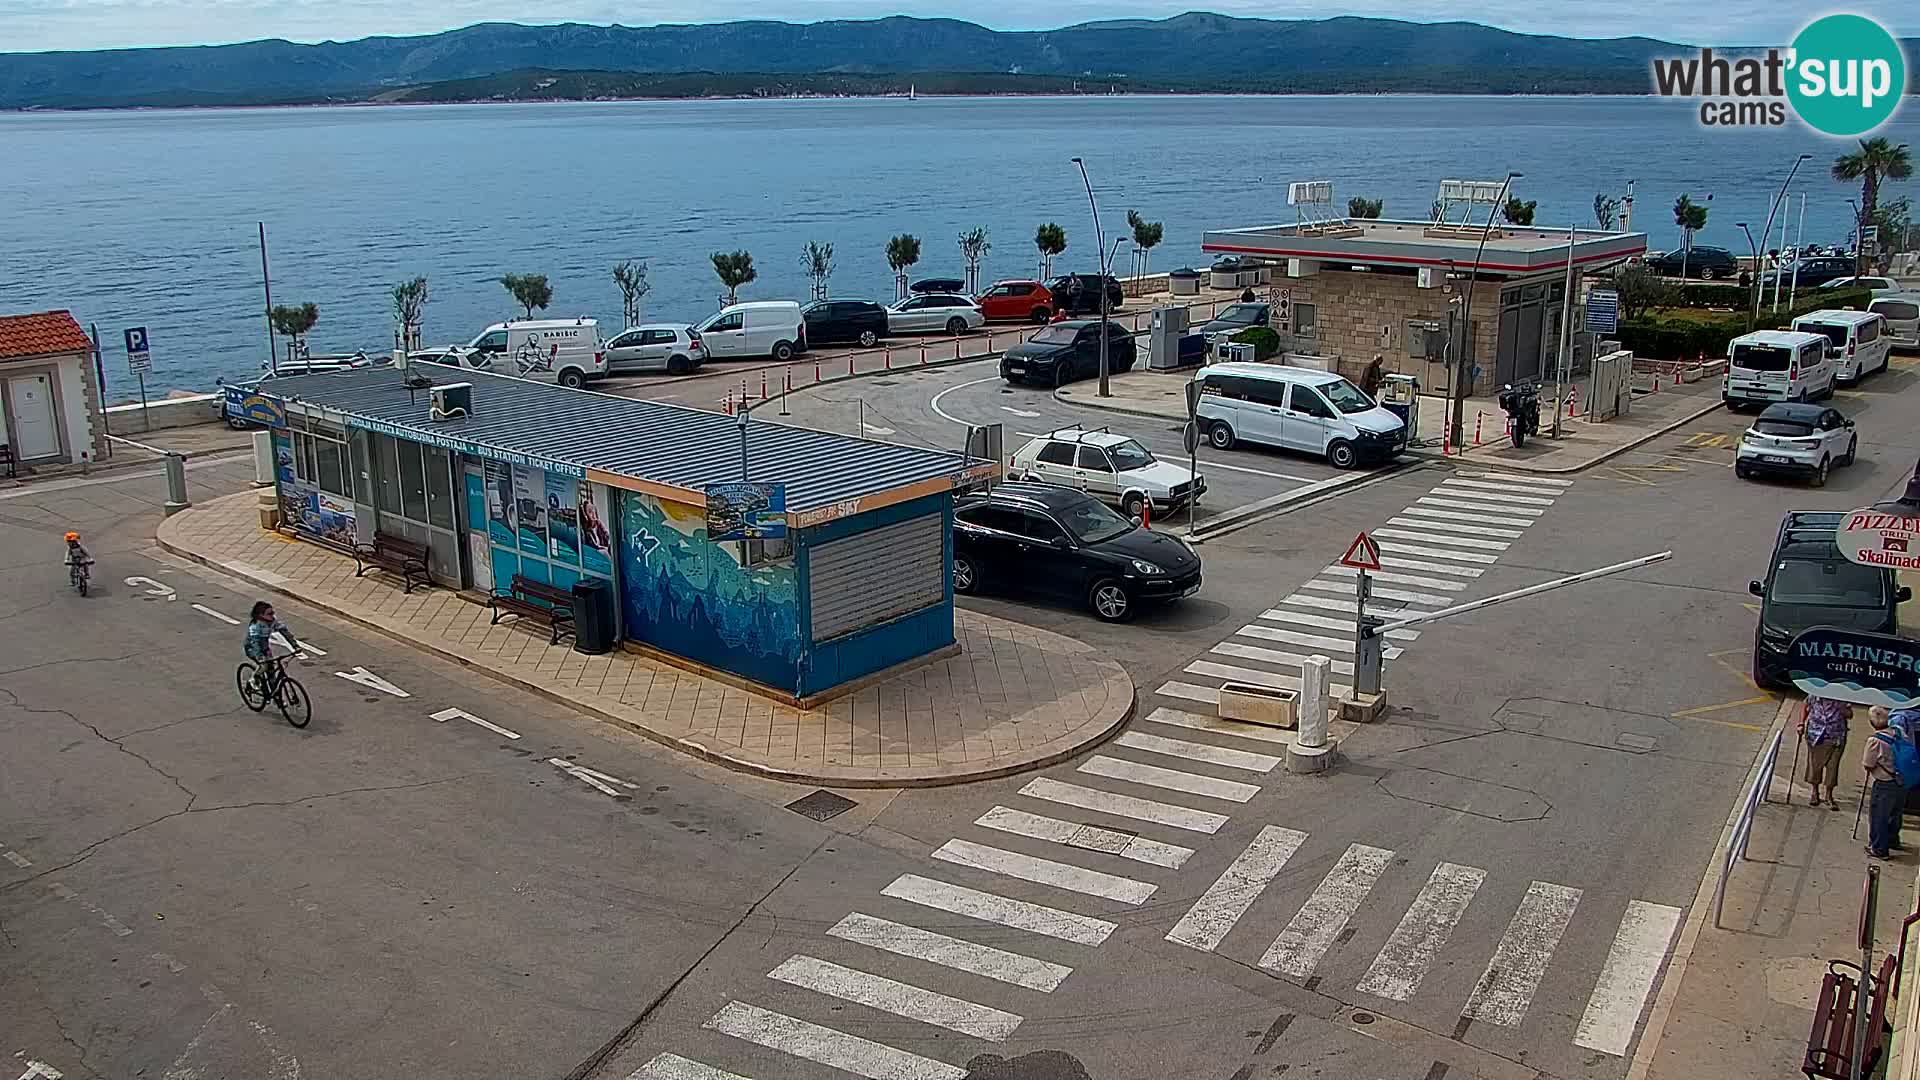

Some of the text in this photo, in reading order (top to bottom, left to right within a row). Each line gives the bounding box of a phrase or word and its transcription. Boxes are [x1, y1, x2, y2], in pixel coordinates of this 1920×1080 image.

[130, 331, 142, 348] P
[436, 436, 467, 451] POSTAJA
[478, 446, 493, 457] BUS
[494, 449, 526, 464] STATION
[527, 457, 554, 470] TICKET
[555, 463, 582, 477] OFFICE
[1879, 530, 1915, 540] GRILL
[1827, 661, 1895, 679] caffe bar
